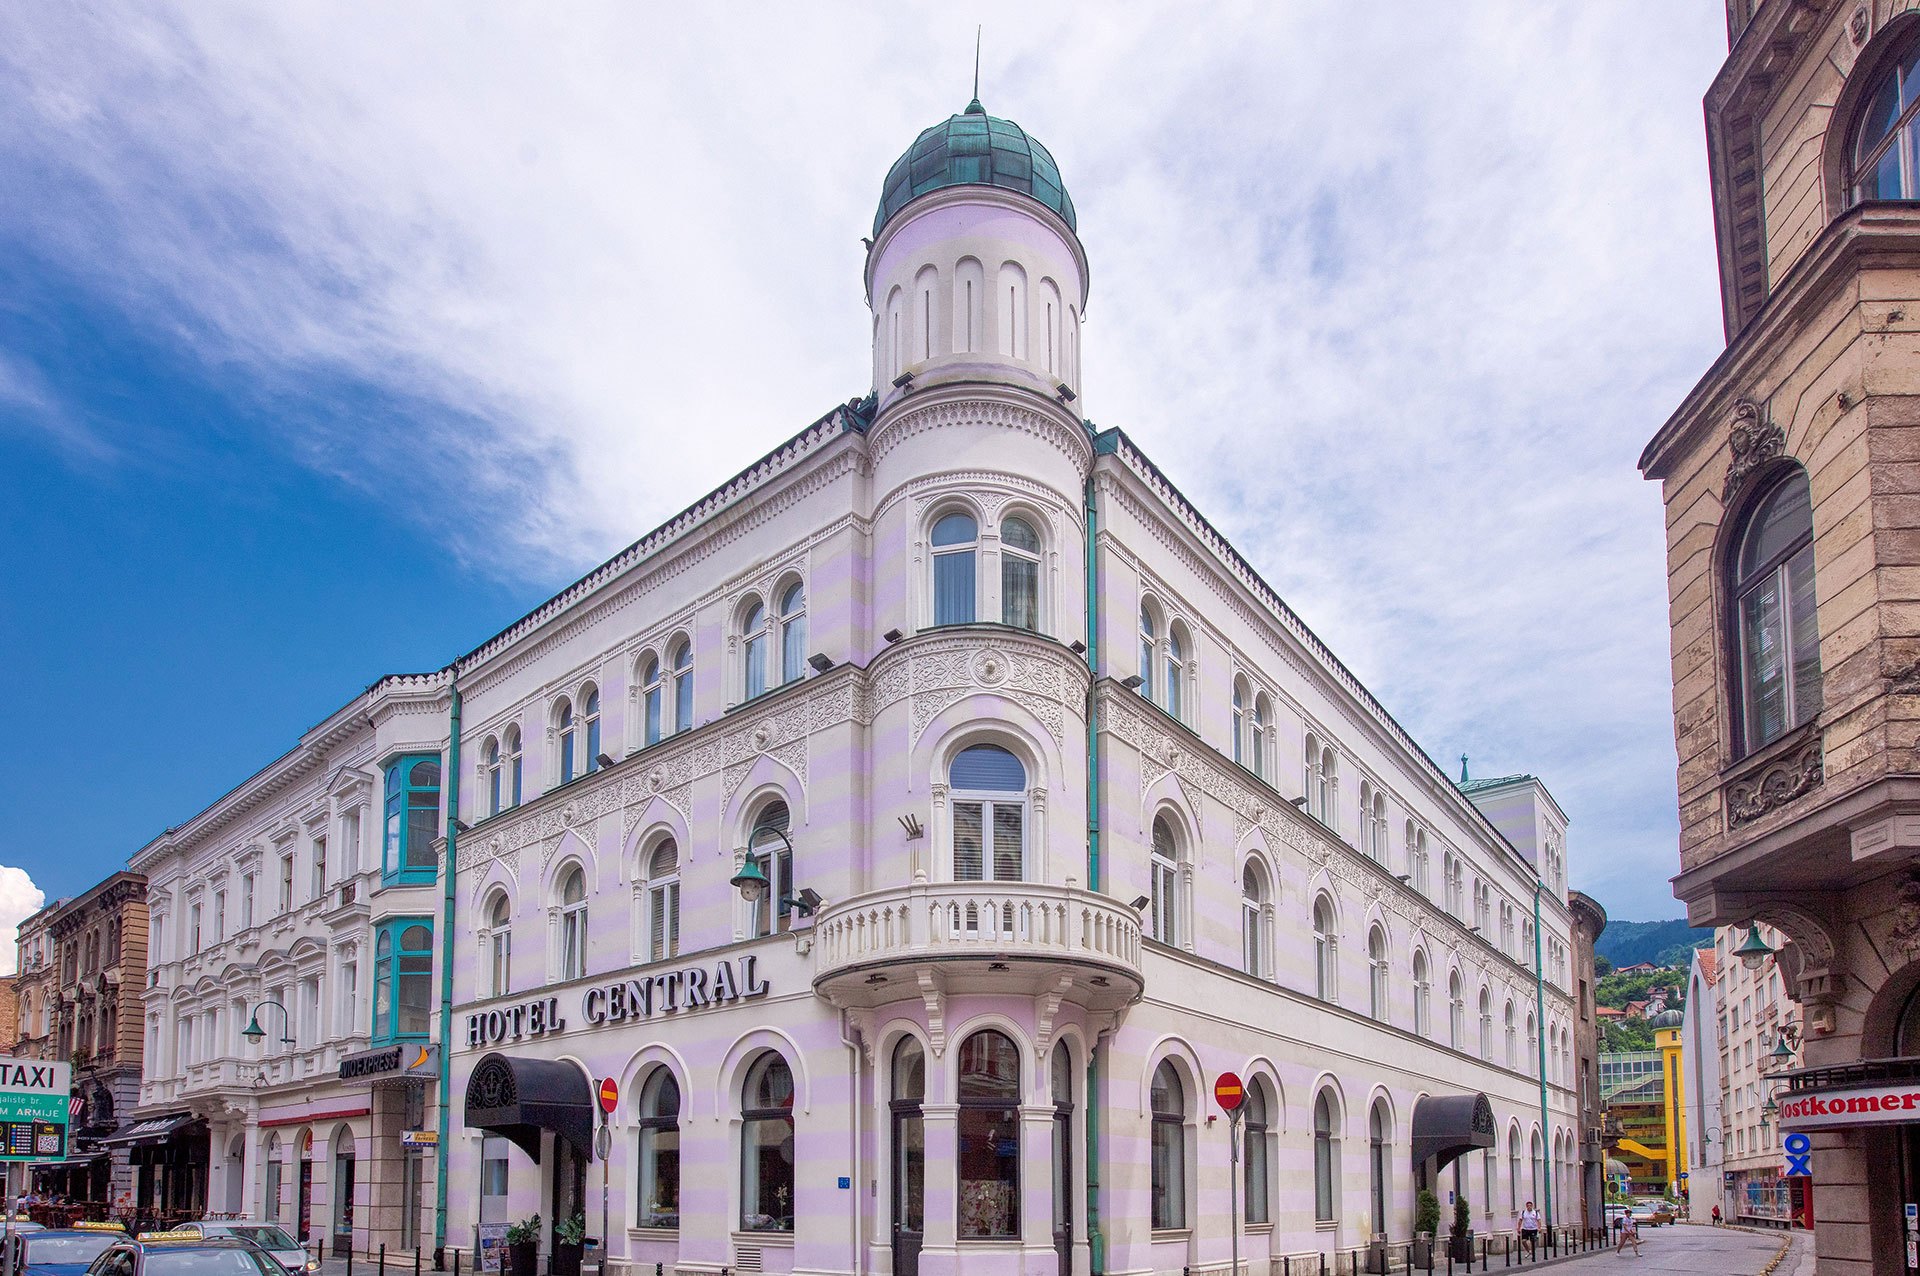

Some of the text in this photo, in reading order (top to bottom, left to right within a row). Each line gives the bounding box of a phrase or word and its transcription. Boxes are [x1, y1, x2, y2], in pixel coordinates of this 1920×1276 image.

[465, 955, 769, 1046] HOTEL CENTRAL
[0, 1064, 55, 1089] TAXI
[31, 1097, 42, 1105] br.
[16, 1108, 60, 1118] ARMIJE
